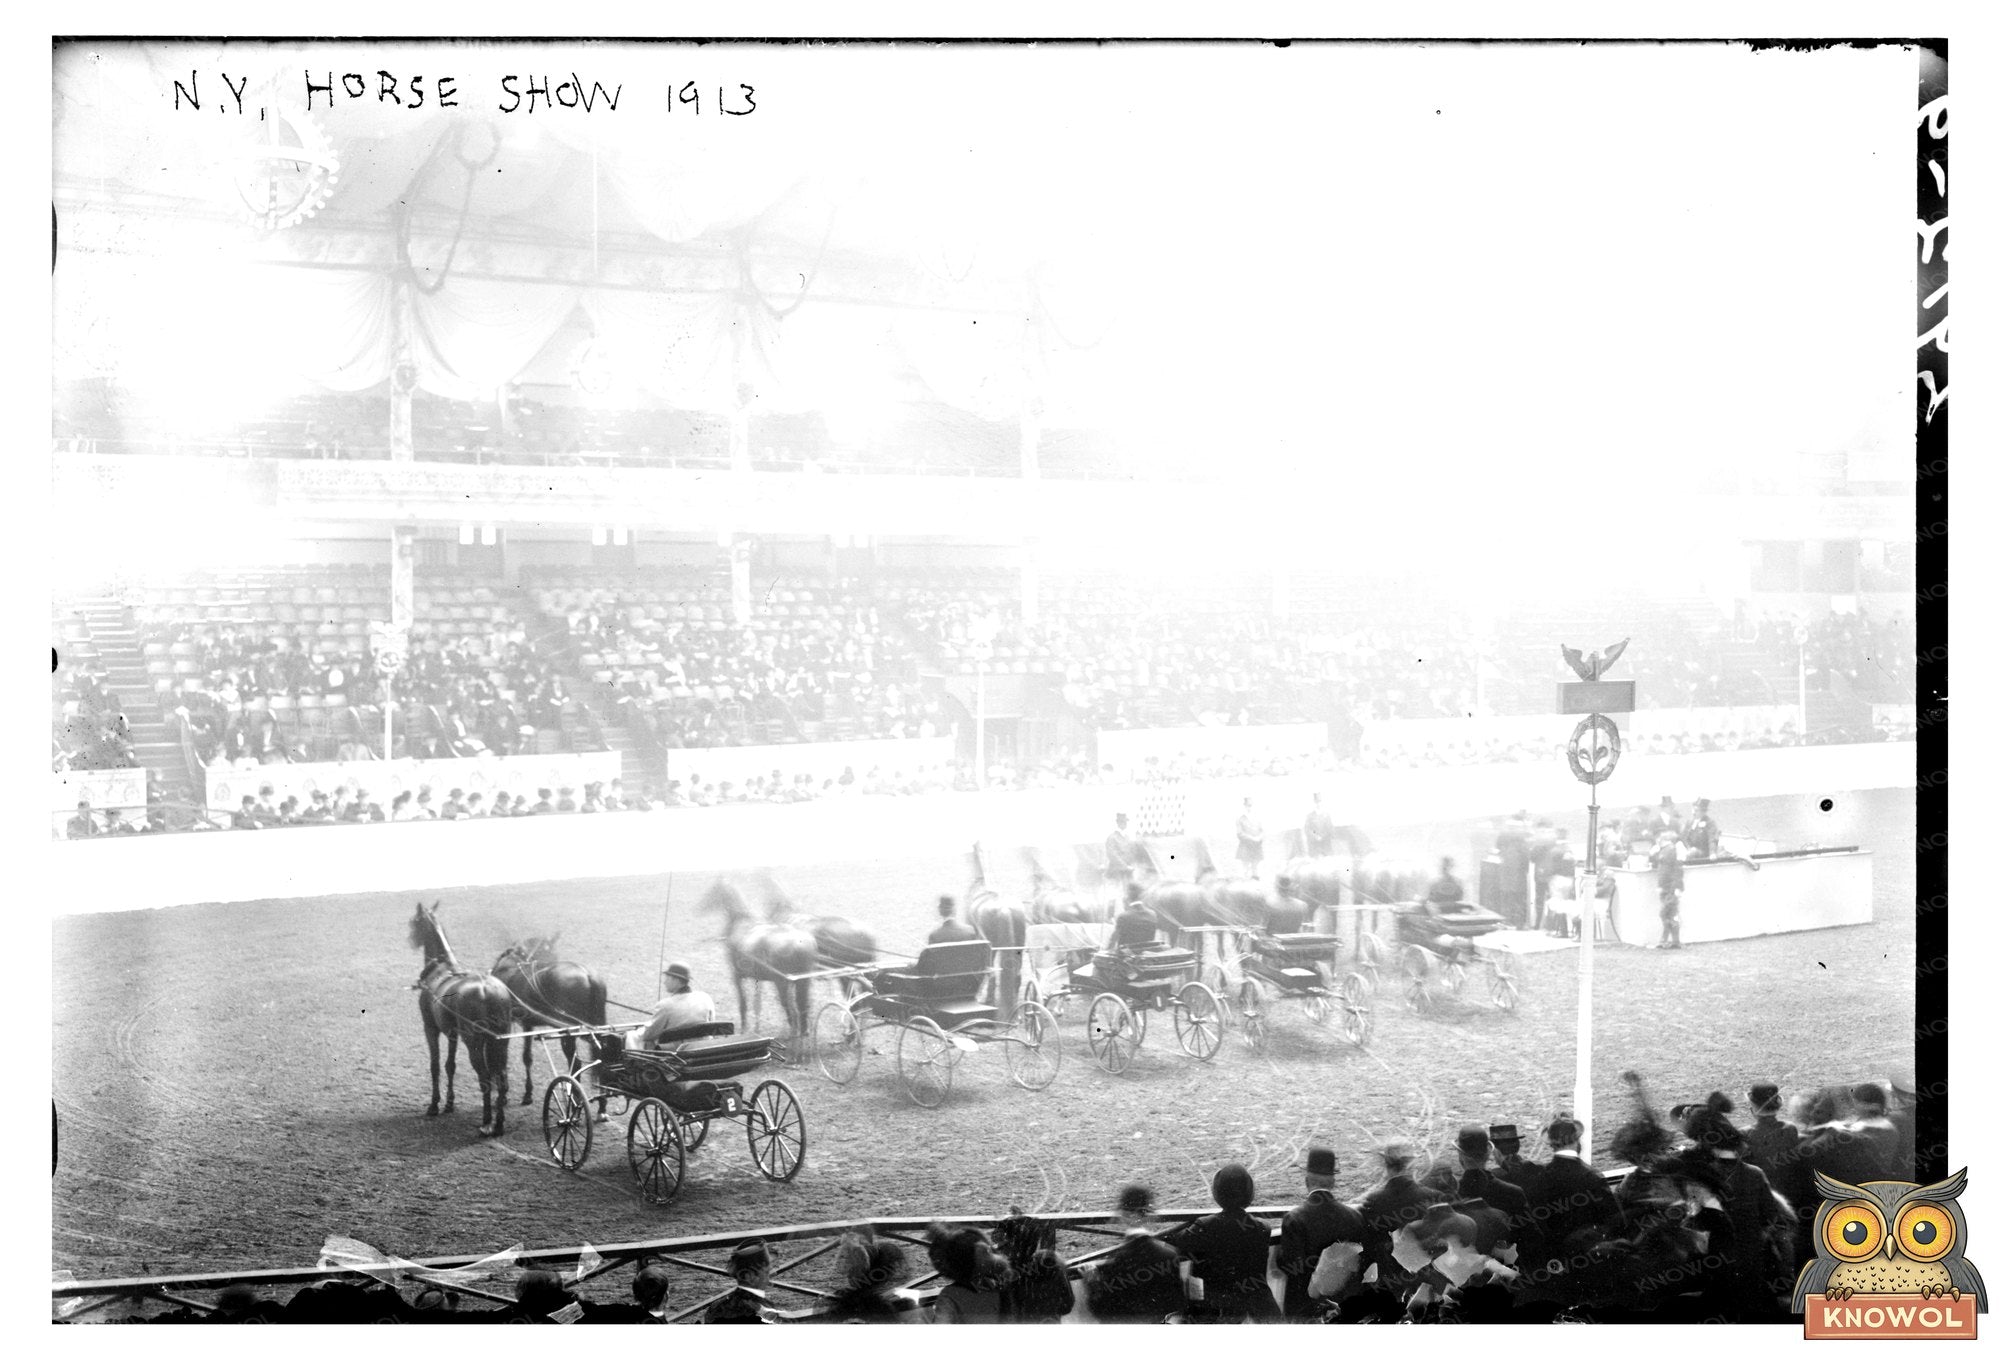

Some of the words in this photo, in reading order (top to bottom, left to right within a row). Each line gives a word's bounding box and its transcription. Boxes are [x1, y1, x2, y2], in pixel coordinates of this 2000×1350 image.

[304, 69, 459, 111] HORSE
[498, 73, 622, 114] SHOW
[667, 81, 757, 115] 1913
[727, 1097, 737, 1112] 2
